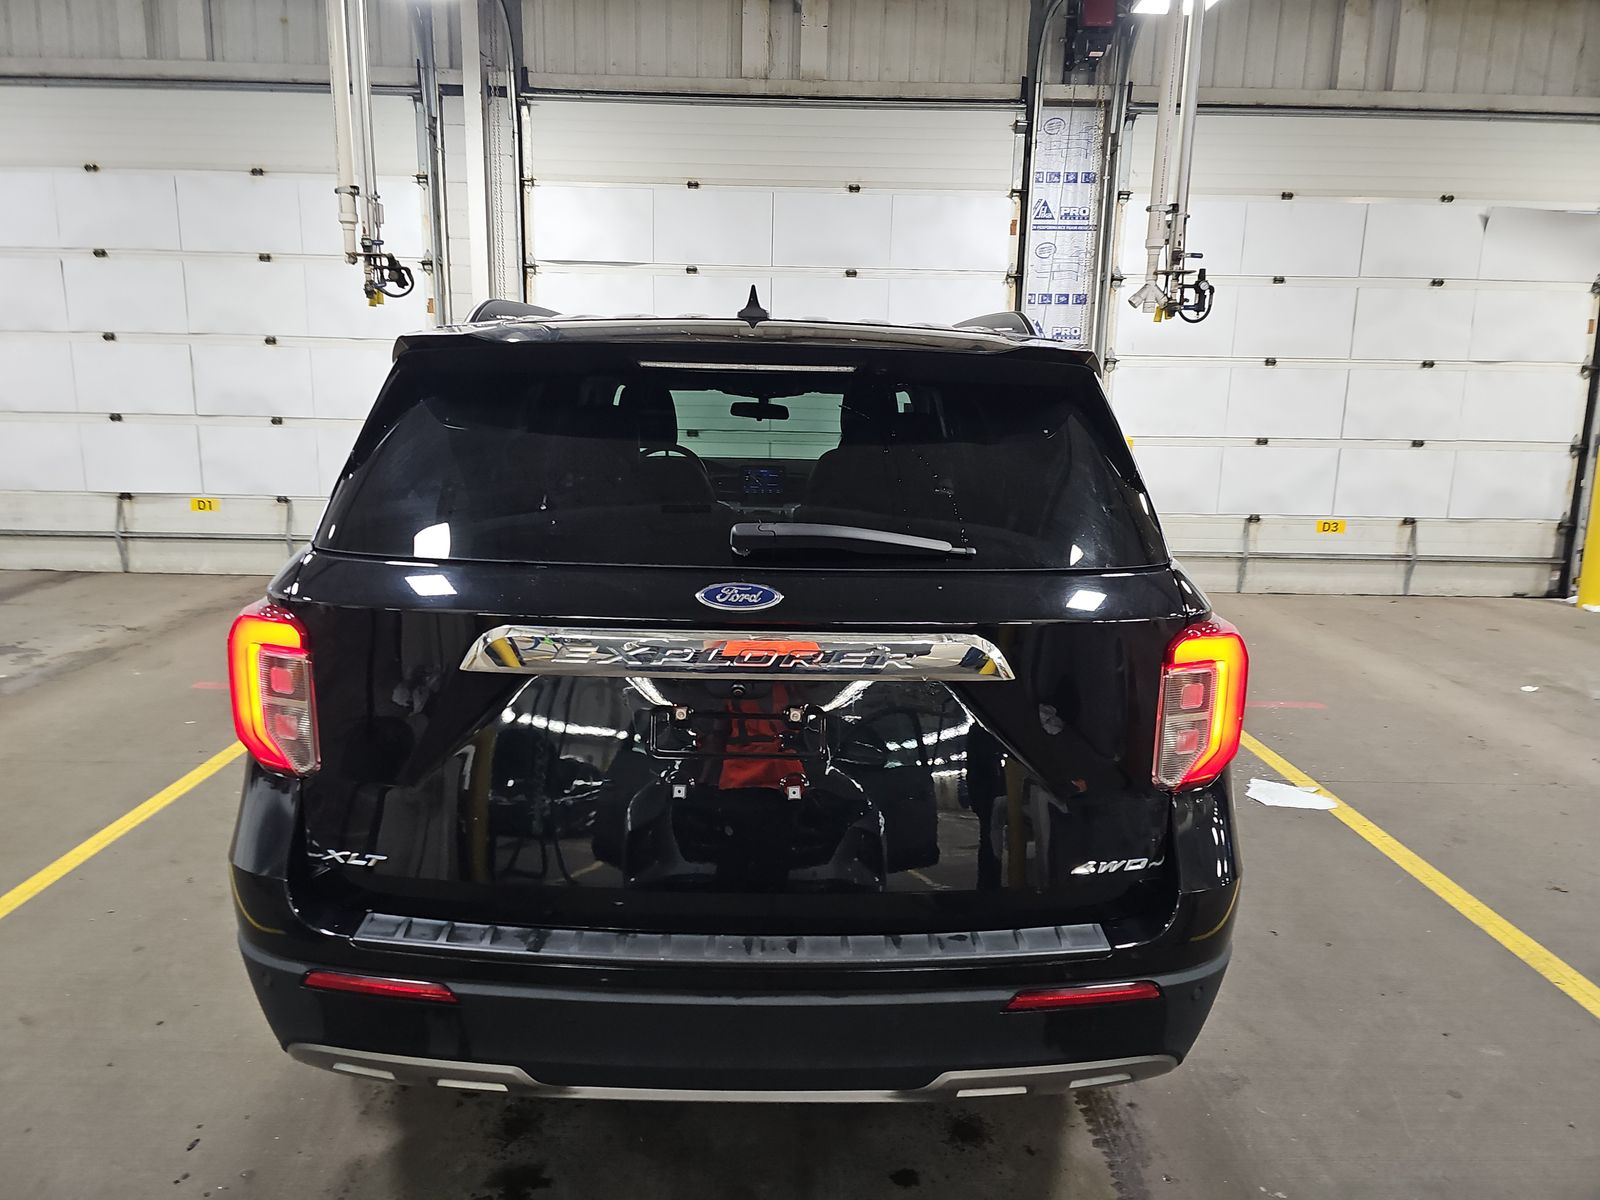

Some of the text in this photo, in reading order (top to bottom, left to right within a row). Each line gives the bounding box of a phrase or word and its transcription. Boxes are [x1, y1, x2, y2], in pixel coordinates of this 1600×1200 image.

[1060, 206, 1090, 216] PRO
[1052, 327, 1081, 336] PRO
[197, 499, 212, 511] D1
[1322, 521, 1339, 532] D3
[716, 586, 763, 603] Ford
[550, 645, 915, 669] EXPLORER
[321, 849, 388, 867] XLT
[1070, 857, 1149, 875] 4WD
